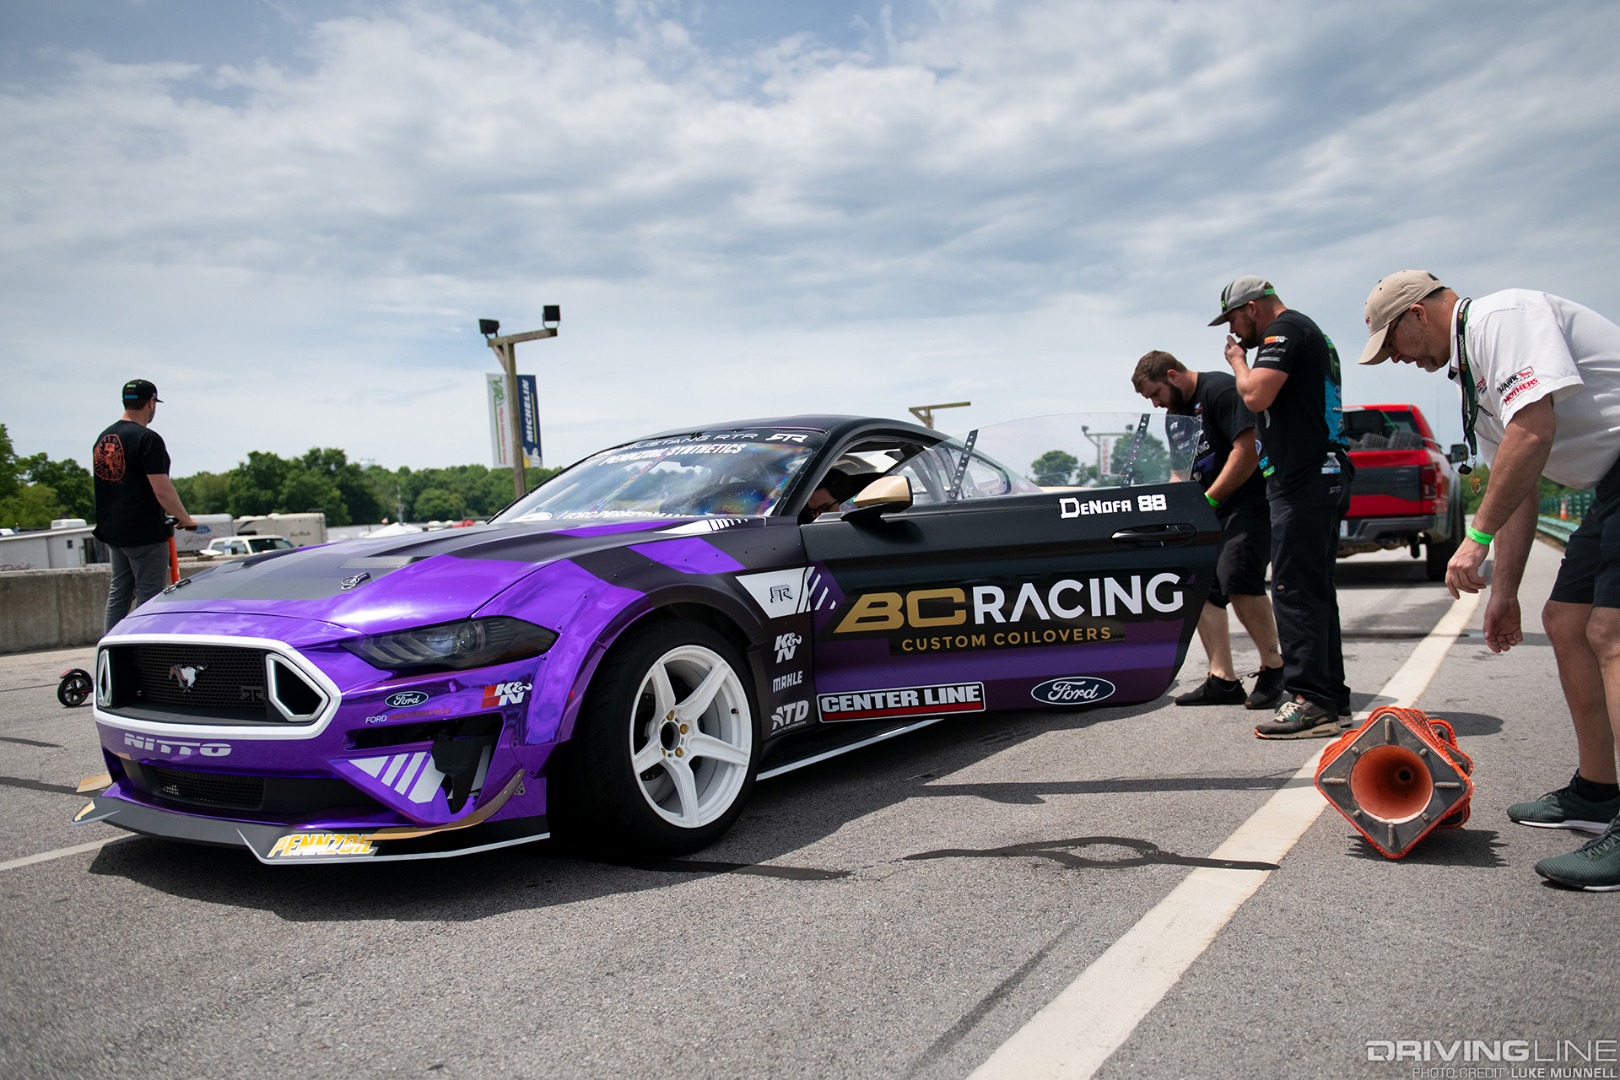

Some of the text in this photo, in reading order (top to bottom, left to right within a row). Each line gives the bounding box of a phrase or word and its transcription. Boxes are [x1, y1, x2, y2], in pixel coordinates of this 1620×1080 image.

[522, 379, 534, 443] MICHELIN
[666, 443, 748, 457] SYNTHETICS
[1137, 494, 1168, 512] 88
[972, 573, 1185, 625] RACING
[774, 632, 803, 664] K&N
[902, 626, 1111, 652] CUSTOM COILOVERS
[494, 681, 532, 706] K&N
[772, 670, 803, 693] MAHLE
[1047, 680, 1101, 700] Ford
[393, 693, 421, 706] Ford
[821, 685, 981, 712] CENTER LINE
[365, 715, 387, 724] FORD
[124, 732, 232, 757] NITTO
[267, 833, 375, 858] PENNZOIL
